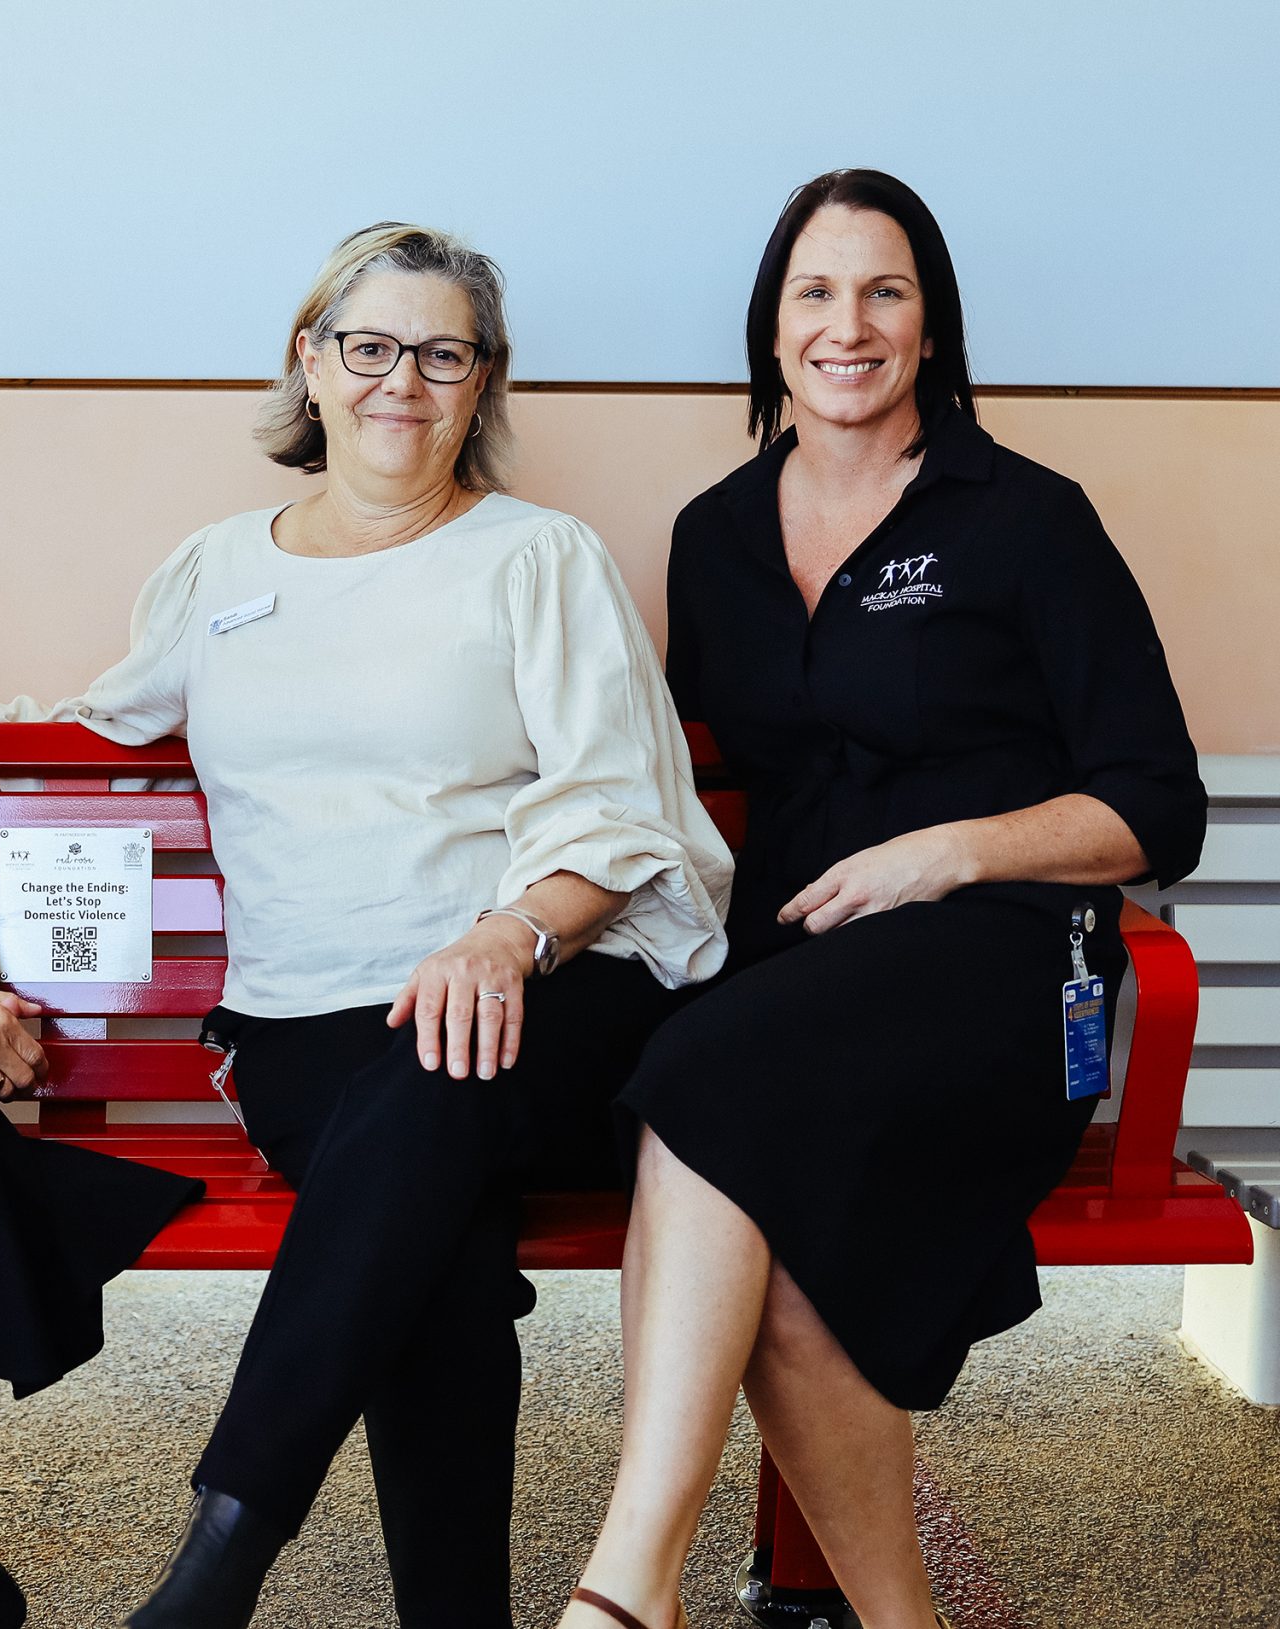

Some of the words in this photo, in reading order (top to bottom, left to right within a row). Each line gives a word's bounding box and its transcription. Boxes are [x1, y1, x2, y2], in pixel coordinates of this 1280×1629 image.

[861, 589, 899, 603] MACKAY
[900, 583, 943, 594] HOSPITAL
[867, 596, 926, 612] FOUNDATION
[21, 882, 63, 894] Change
[66, 882, 84, 893] the
[87, 882, 129, 894] Ending:
[46, 896, 72, 906] Let's
[75, 896, 101, 908] Stop
[24, 910, 76, 921] Domestic
[78, 910, 126, 921] Violence
